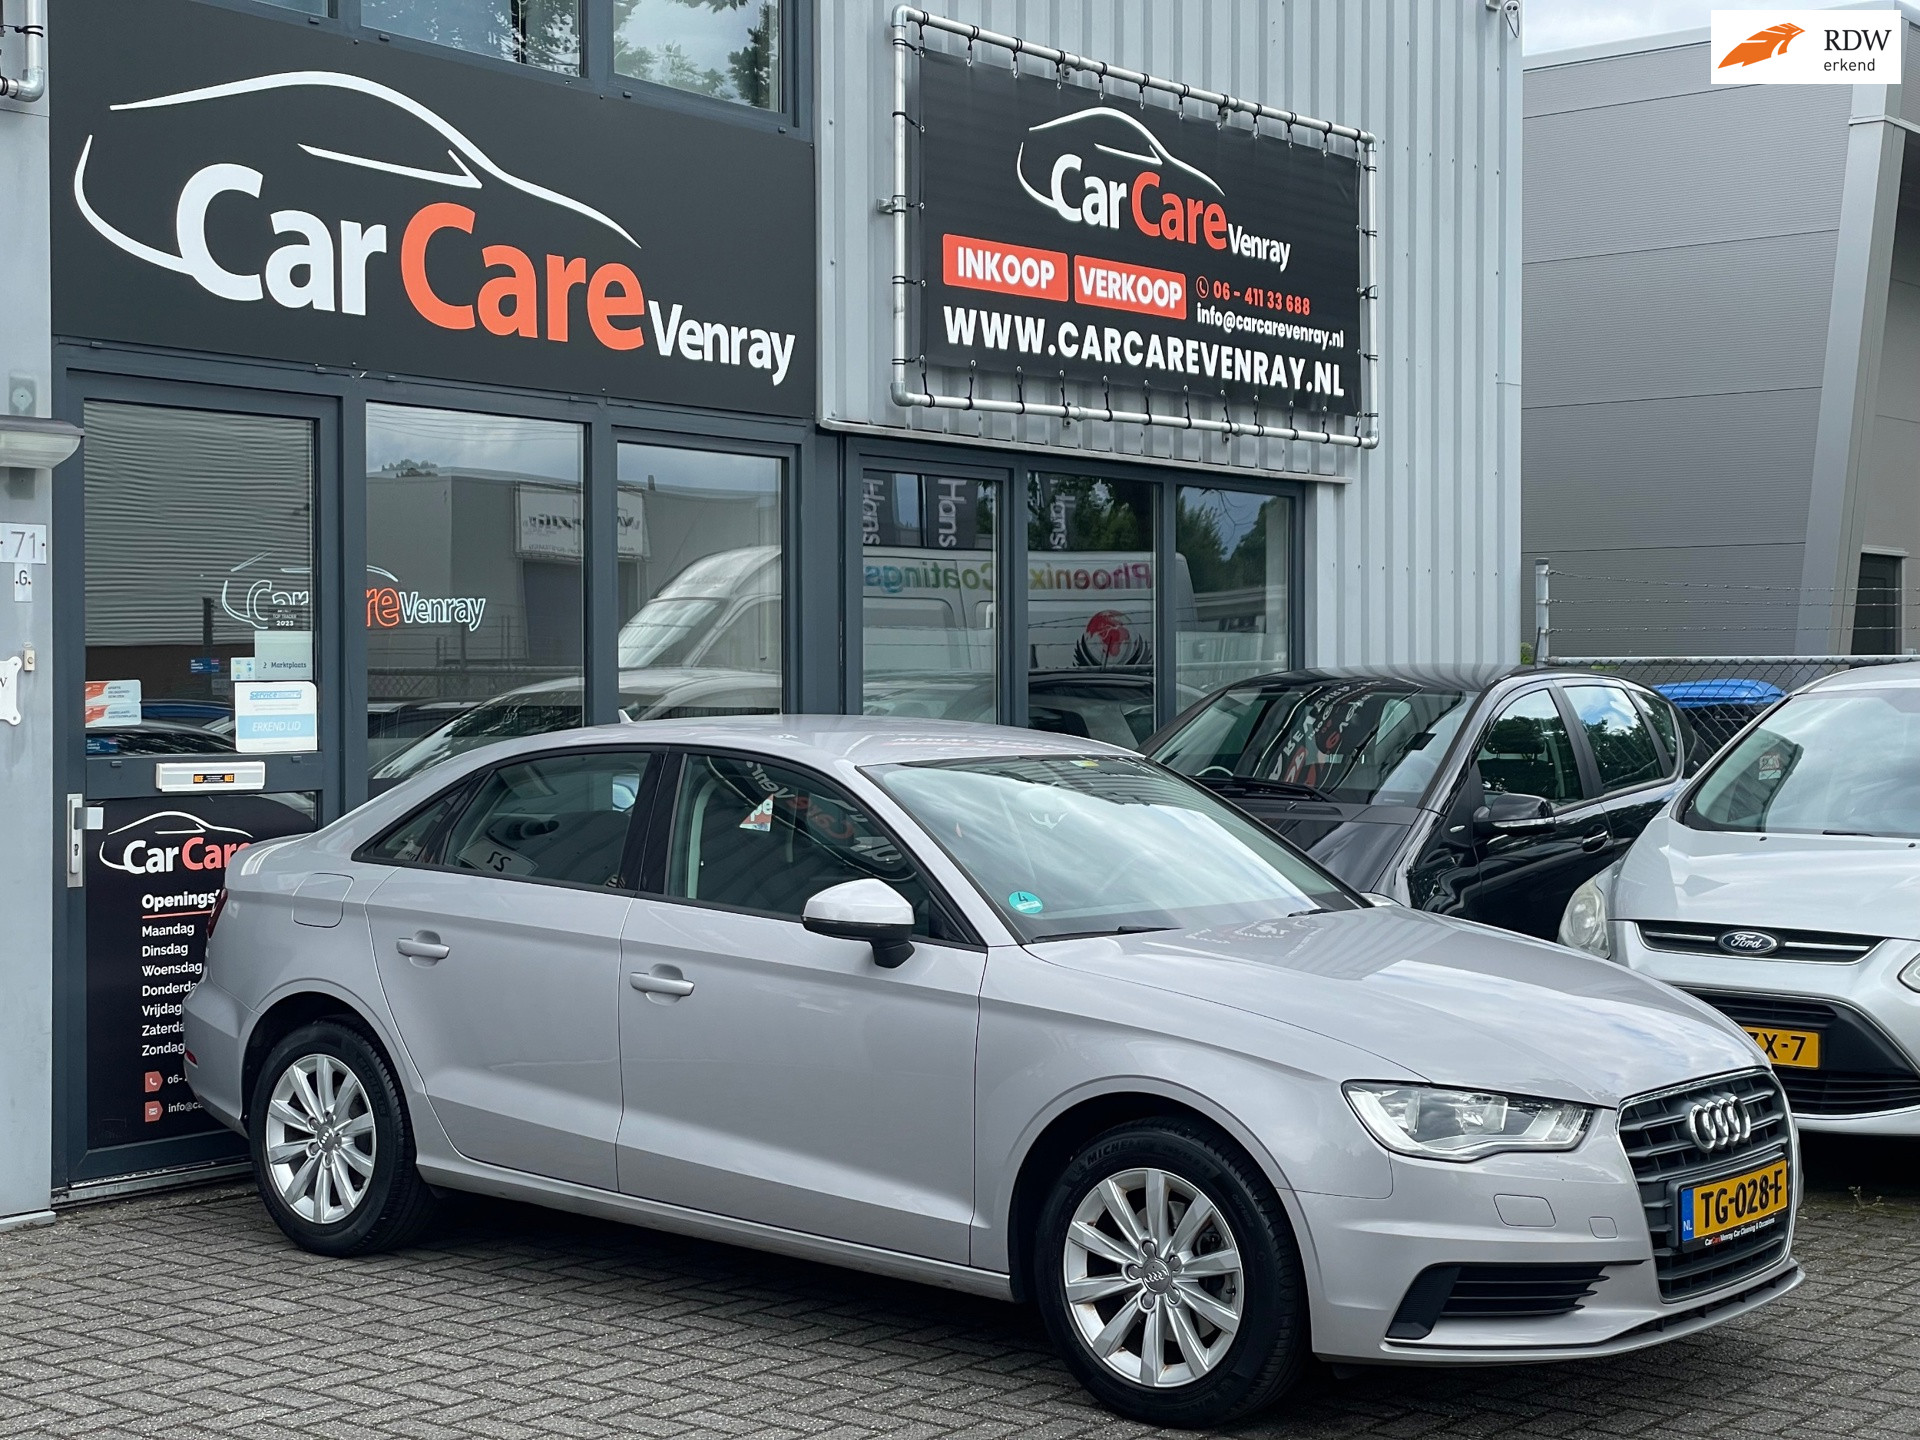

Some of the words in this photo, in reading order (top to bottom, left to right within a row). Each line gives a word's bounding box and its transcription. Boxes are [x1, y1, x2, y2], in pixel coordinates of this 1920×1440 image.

[1227, 222, 1292, 272] Venray
[956, 245, 1055, 290] INKOOP
[1078, 264, 1184, 310] VERKOOP
[1213, 280, 1230, 301] 06
[1244, 287, 1264, 308] 411
[1266, 290, 1283, 311] 33
[1286, 294, 1311, 316] 688
[1196, 302, 1345, 350] info@carcarevenray.nl
[648, 300, 796, 387] Venray
[942, 305, 1346, 398] WWW.CARCAREVENRAY.NL
[937, 478, 967, 548] Hans
[11, 531, 36, 559] 71
[19, 569, 29, 587] G
[398, 591, 487, 632] Venray
[270, 661, 307, 670] Marktplaats
[252, 721, 287, 732] ERKEND
[288, 720, 301, 731] LID
[123, 836, 252, 875] CarCar
[141, 923, 195, 937] Maandag
[1730, 932, 1763, 949] Ford
[141, 943, 189, 957] Dinsdag
[141, 961, 203, 977] Woensdag
[141, 1002, 183, 1018] Vrijdag
[141, 1042, 186, 1056] Zondag
[1700, 1169, 1783, 1229] TG-028-F
[1683, 1219, 1693, 1232] NL
